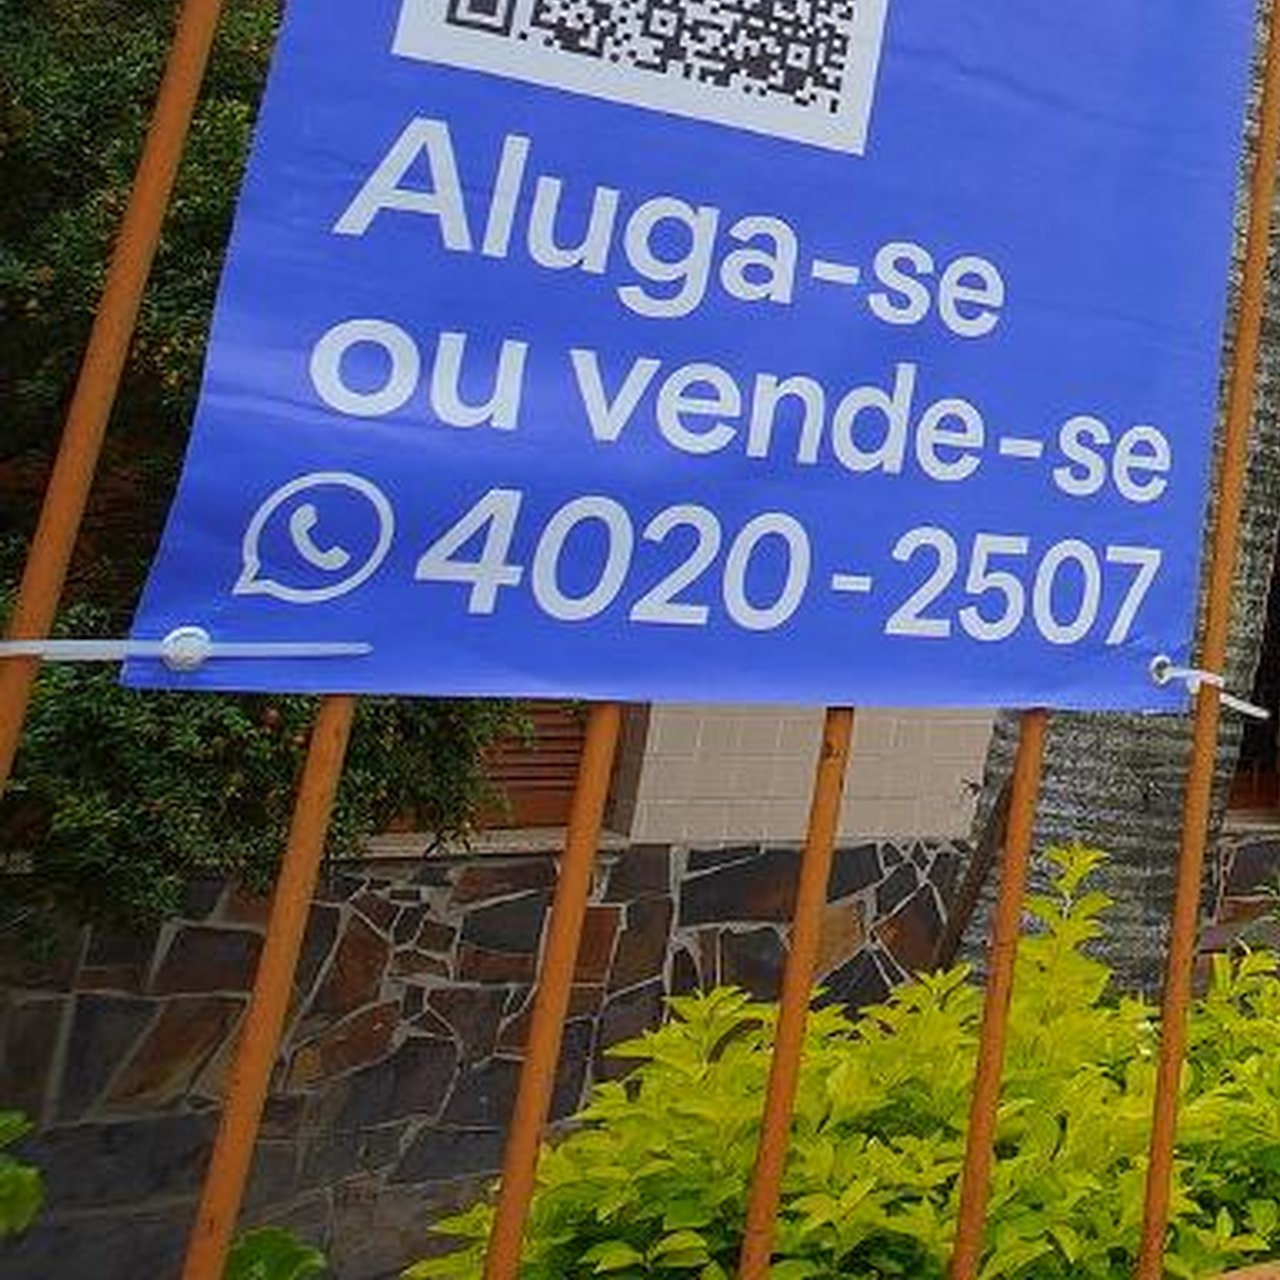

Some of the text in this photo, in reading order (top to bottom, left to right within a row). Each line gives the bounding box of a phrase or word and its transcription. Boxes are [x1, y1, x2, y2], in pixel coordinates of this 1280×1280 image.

[333, 118, 1004, 338] Aluga-se
[308, 319, 1172, 504] ou vende-se
[415, 488, 1163, 646] 4020-2507
